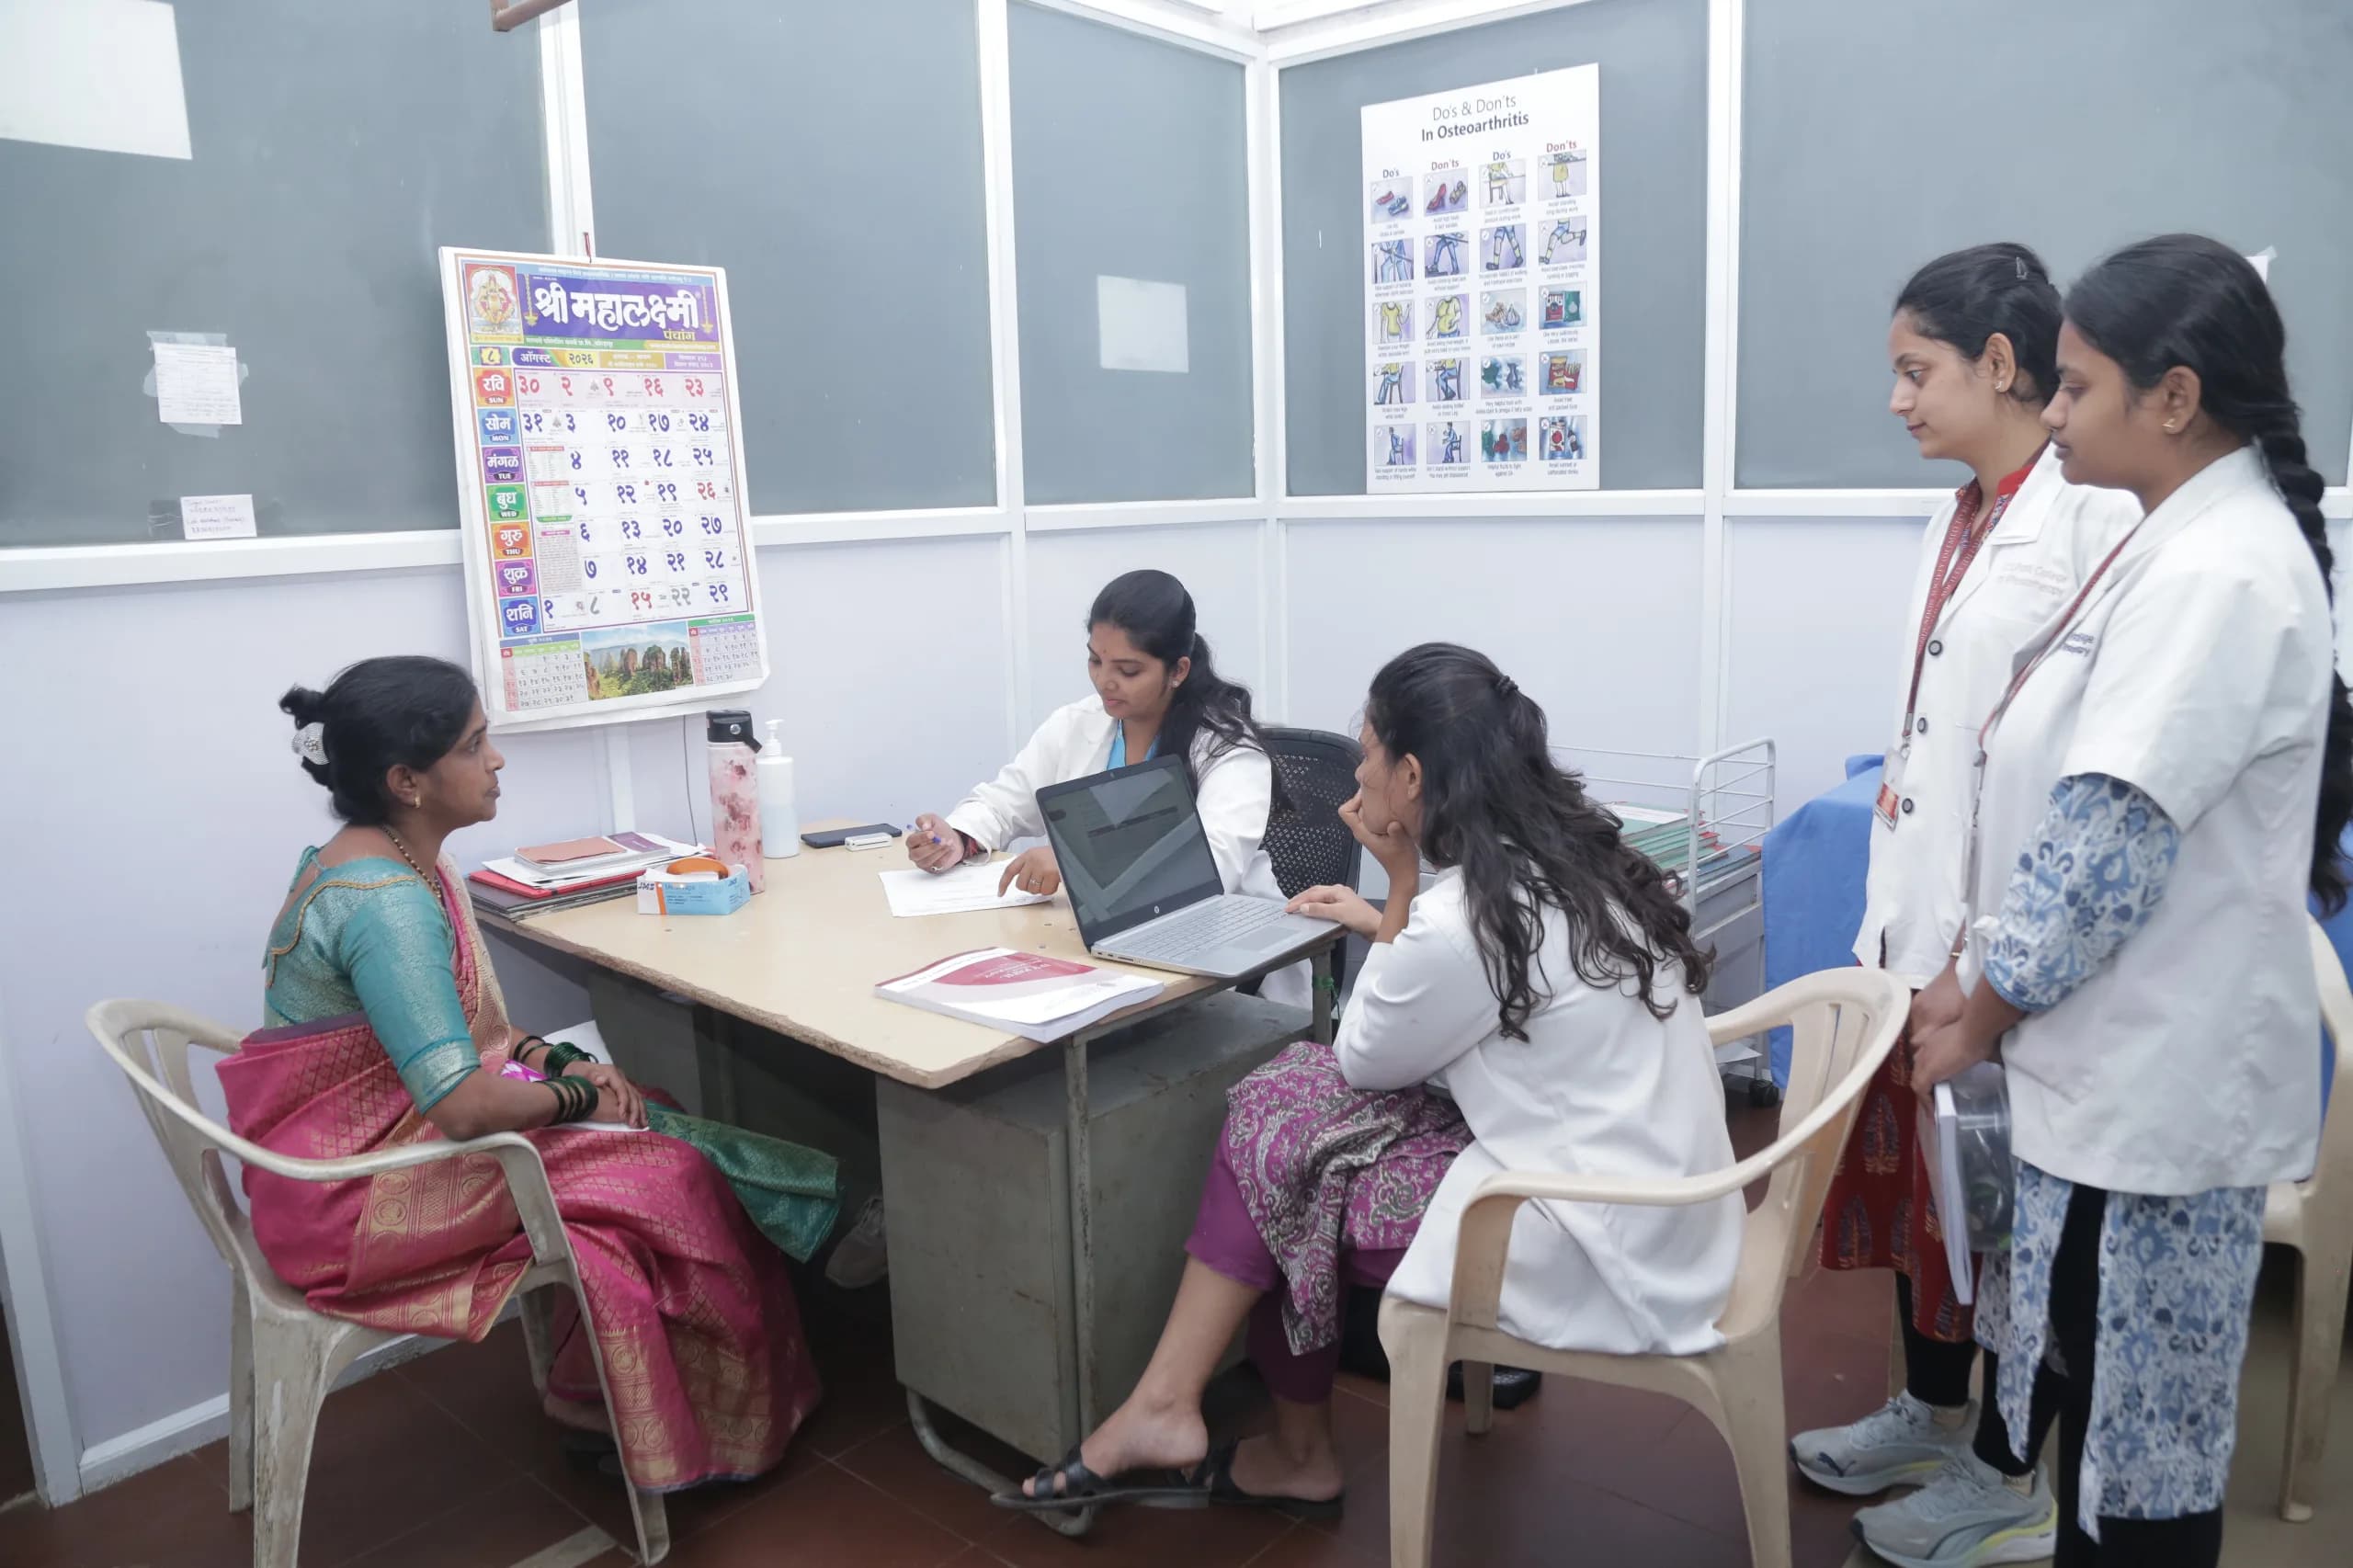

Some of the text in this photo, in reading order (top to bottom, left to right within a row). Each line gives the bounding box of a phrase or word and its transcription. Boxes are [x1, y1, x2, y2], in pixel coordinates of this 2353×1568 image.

[1433, 95, 1517, 121] Do's & Don'ts
[1422, 111, 1529, 142] In Osteoarthritis
[1493, 150, 1511, 162] Do's
[1546, 140, 1577, 153] Don'ts
[1382, 168, 1400, 178] Do's
[1431, 159, 1460, 171] Don'ts
[534, 281, 699, 332] श्री महालक्ष्मी
[519, 350, 552, 364] ऑगस्ट
[568, 353, 595, 367] २०२६
[482, 373, 506, 393] रवि
[518, 375, 540, 395] ३०
[561, 377, 574, 396] २
[603, 377, 615, 396] ९
[644, 378, 665, 397] १६
[685, 378, 705, 397] २३
[483, 413, 512, 432] सोम
[522, 414, 543, 433] ३१
[565, 414, 577, 433] ३
[607, 414, 627, 433] १०
[648, 414, 671, 433] १७
[688, 414, 710, 433] २४
[486, 451, 520, 470] मंगळ
[571, 451, 582, 470] ४
[611, 449, 631, 469] ११
[653, 449, 674, 467] १८
[692, 448, 714, 466] २५
[495, 491, 517, 510] बुध
[575, 487, 588, 506] ५
[617, 485, 637, 504] १२
[657, 483, 678, 502] १९
[697, 482, 717, 501] २६
[580, 523, 591, 542] ६
[621, 520, 642, 540] १३
[663, 518, 683, 537] २०
[701, 516, 722, 535] २७
[499, 528, 523, 547] गुरु
[585, 560, 597, 579] ७
[626, 555, 648, 575] १४
[666, 552, 686, 572] २१
[705, 551, 725, 569] २८
[503, 566, 529, 585] शुक्र
[631, 591, 653, 610] १५
[671, 587, 692, 606] २२
[709, 584, 729, 603] २९
[506, 603, 535, 621] शनि
[544, 600, 554, 619] १
[590, 596, 600, 615] ८
